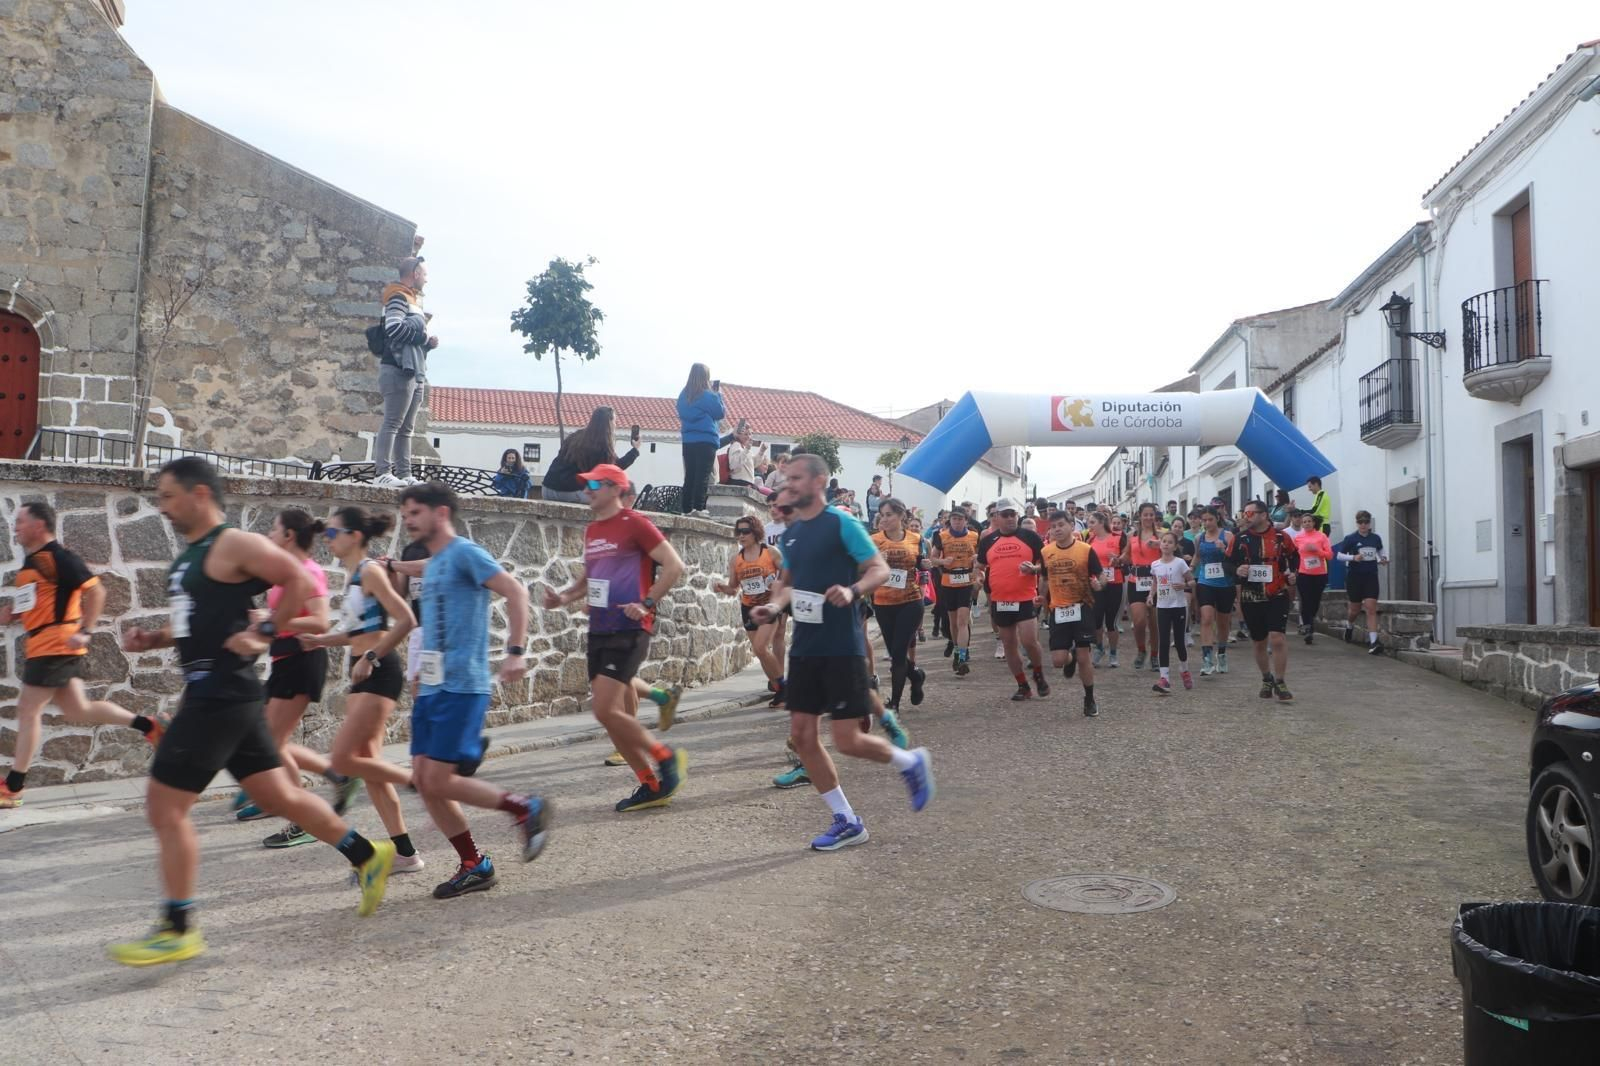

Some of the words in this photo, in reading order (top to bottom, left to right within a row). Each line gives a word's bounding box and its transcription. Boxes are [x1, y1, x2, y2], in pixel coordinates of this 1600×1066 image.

[1101, 401, 1182, 415] Diputación
[1101, 416, 1120, 428] de
[1123, 415, 1183, 428] Córdoba
[1252, 569, 1268, 578] 386
[746, 582, 760, 590] 359
[1060, 609, 1075, 618] 399
